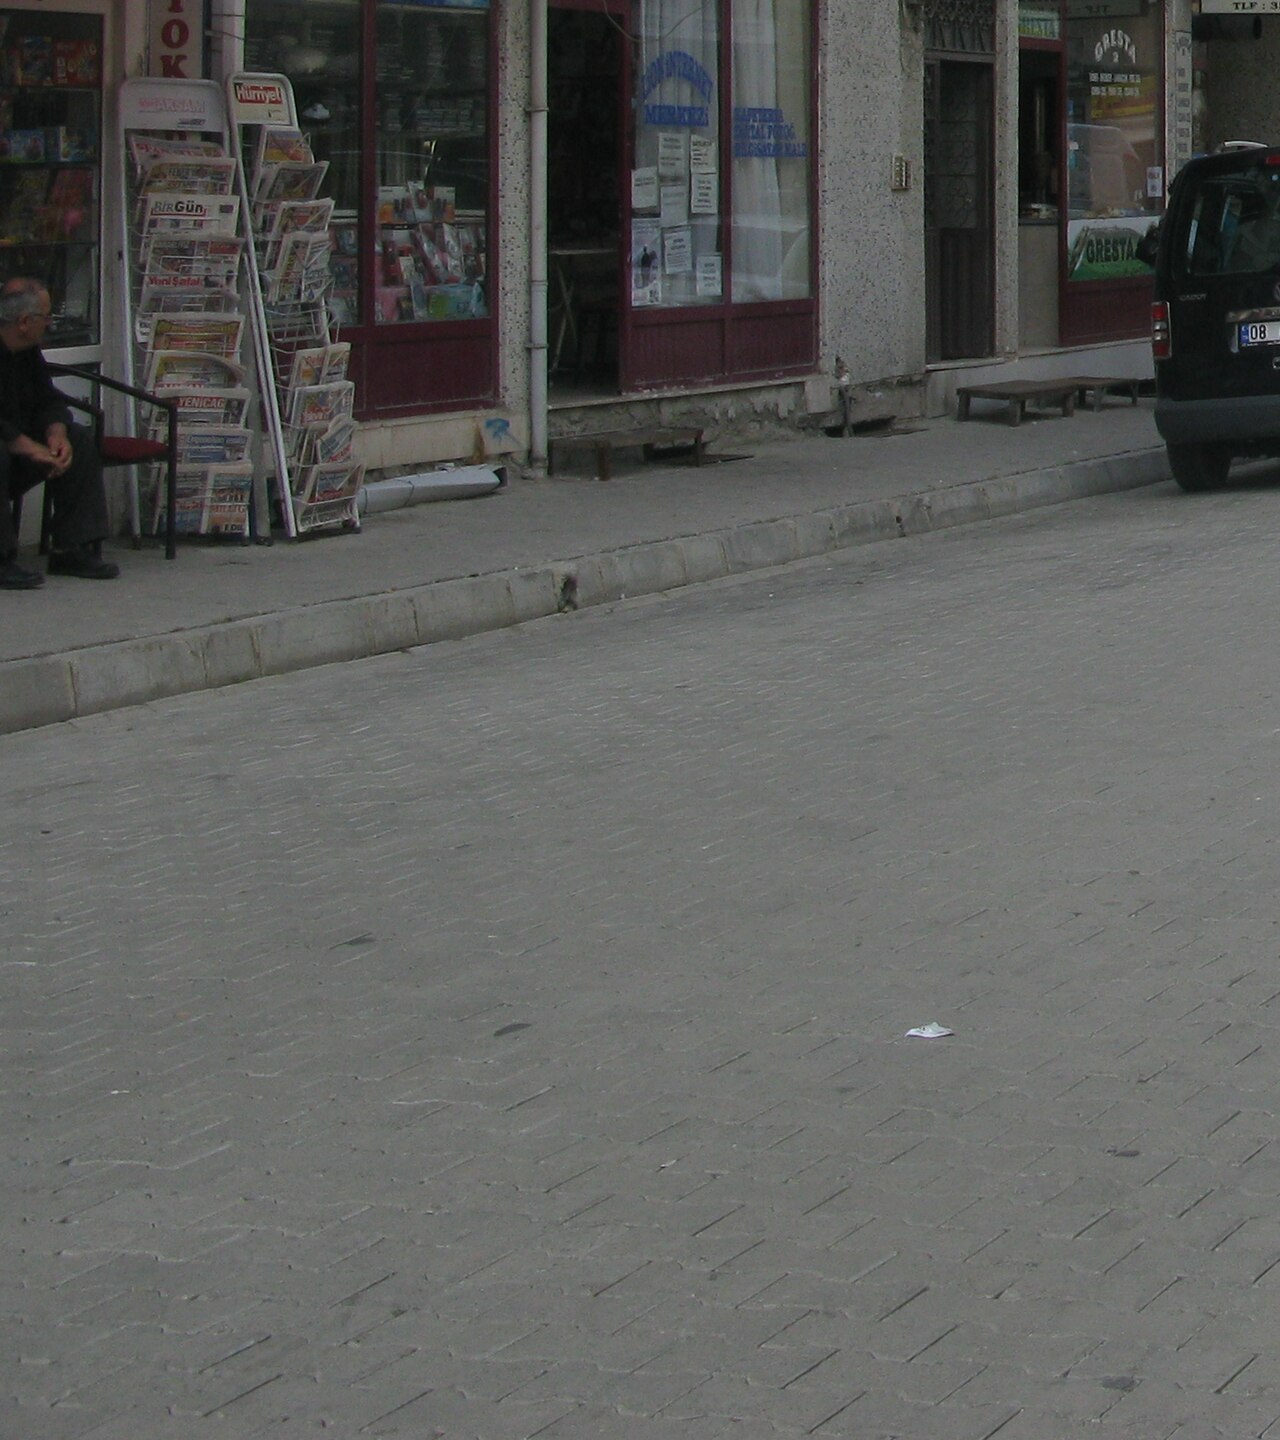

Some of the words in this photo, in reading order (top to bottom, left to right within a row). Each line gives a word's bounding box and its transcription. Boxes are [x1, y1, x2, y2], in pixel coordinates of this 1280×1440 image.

[1094, 29, 1137, 64] GRESTA
[235, 85, 284, 105] Hürriyet
[1085, 235, 1136, 264] GRESTA
[1250, 324, 1267, 340] 08
